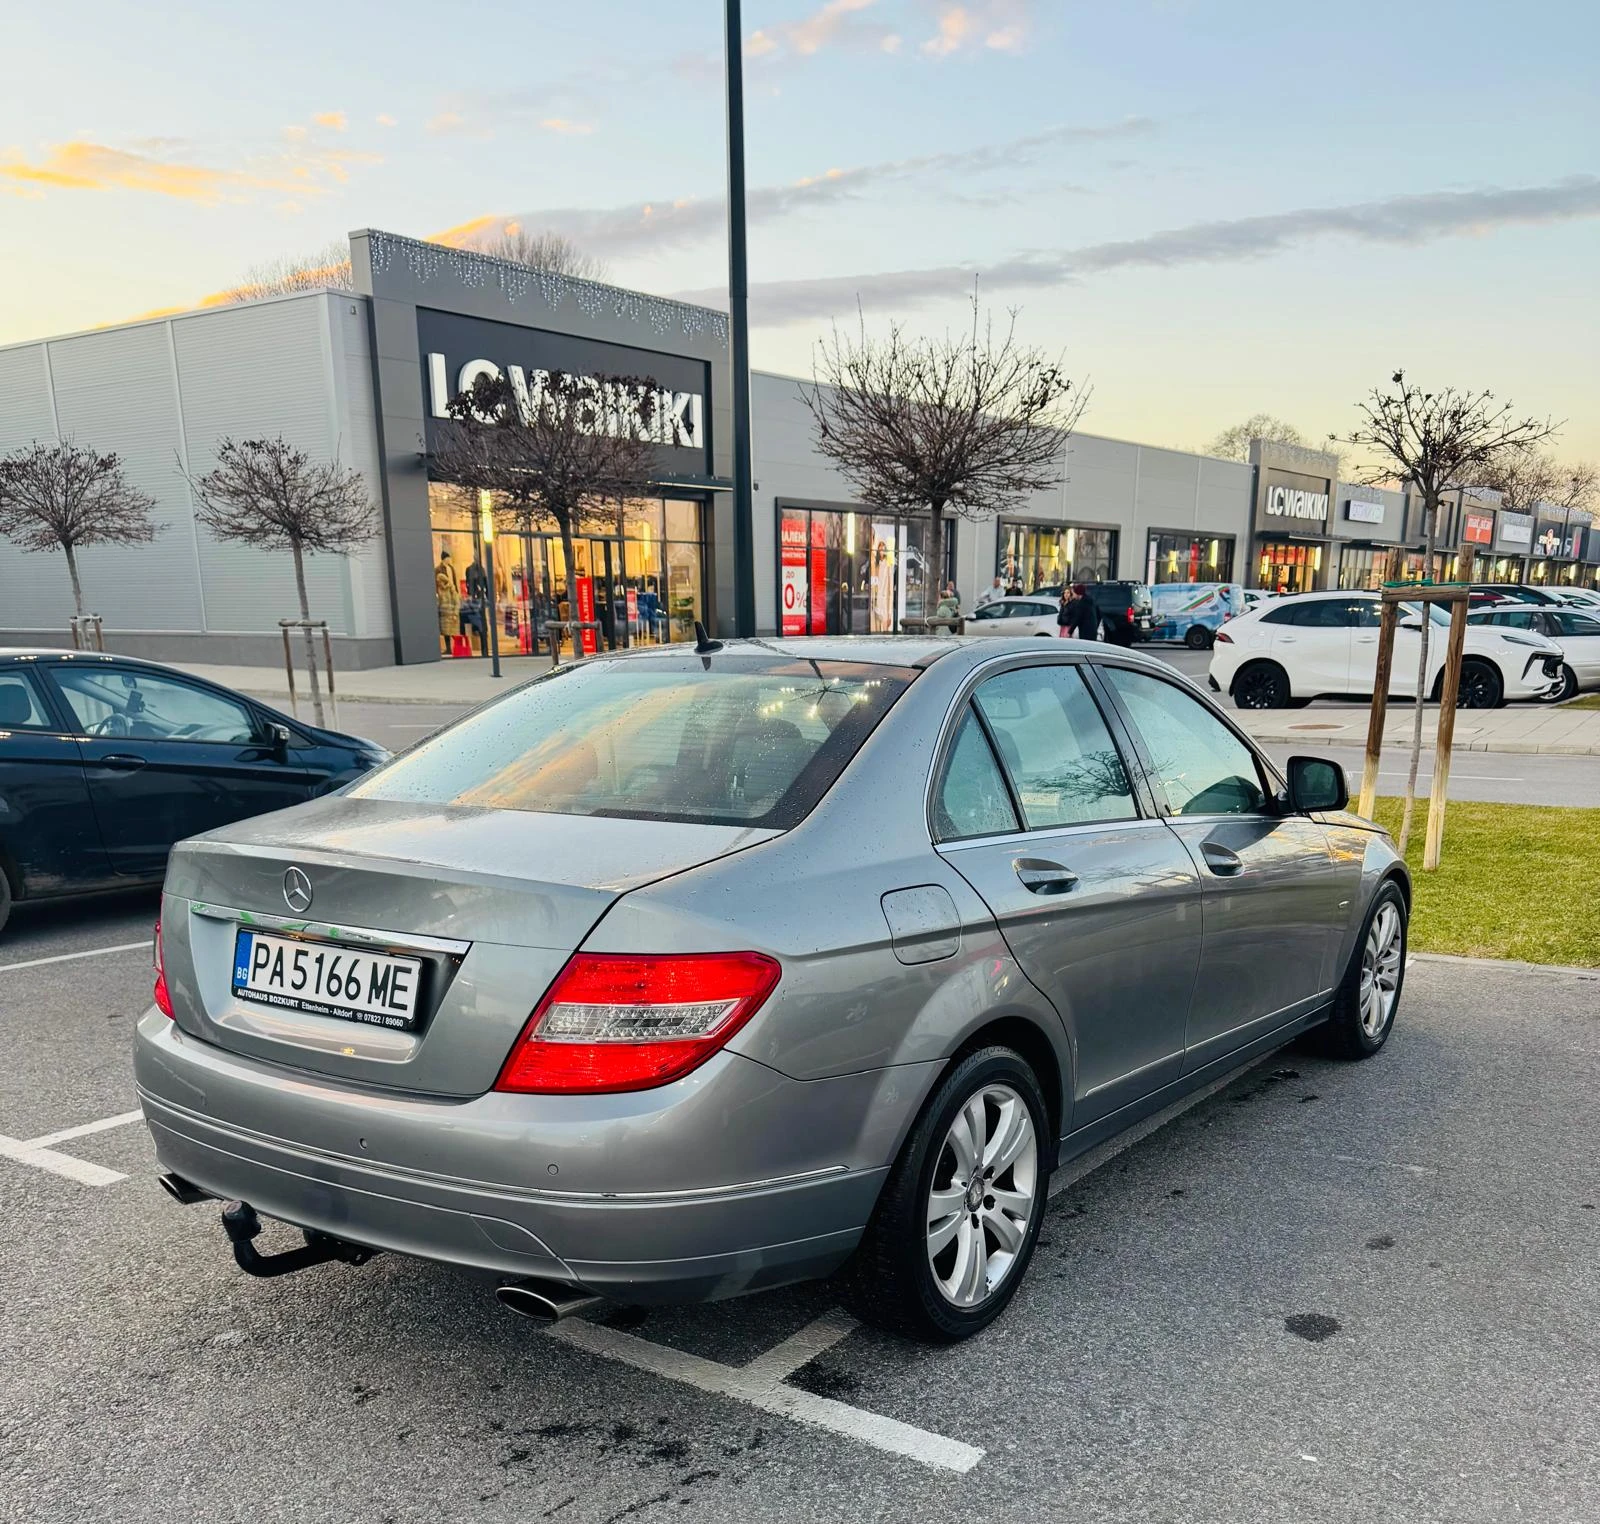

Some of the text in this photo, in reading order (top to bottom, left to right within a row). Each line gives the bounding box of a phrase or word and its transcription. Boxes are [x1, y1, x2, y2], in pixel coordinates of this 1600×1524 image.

[236, 966, 248, 980] BG
[237, 989, 268, 1001] AUTOHAUS
[269, 995, 299, 1007] BOZKURT
[333, 1008, 353, 1019] Altdorf
[363, 1013, 381, 1024] 07822
